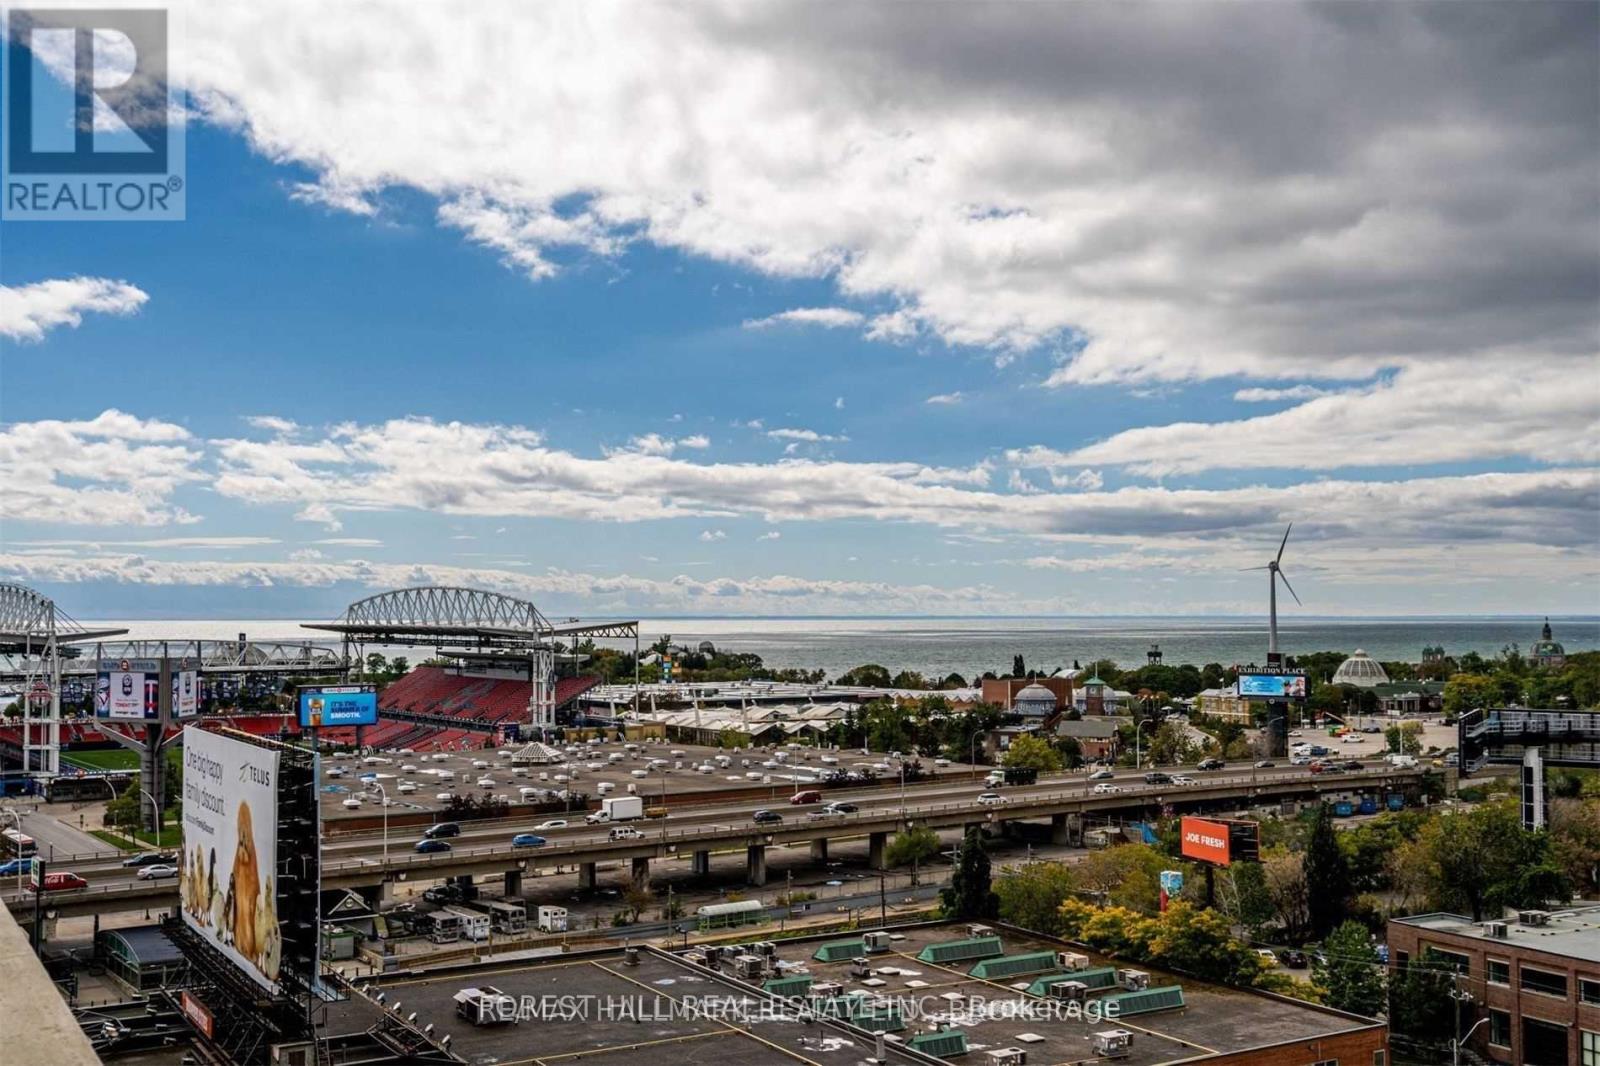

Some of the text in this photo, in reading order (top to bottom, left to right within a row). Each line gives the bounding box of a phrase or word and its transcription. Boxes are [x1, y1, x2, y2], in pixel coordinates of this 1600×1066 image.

[1238, 666, 1306, 675] EXHIBITION PLACE
[186, 745, 197, 770] One
[250, 765, 270, 787] TELUS
[1185, 831, 1225, 849] JOE FRESH
